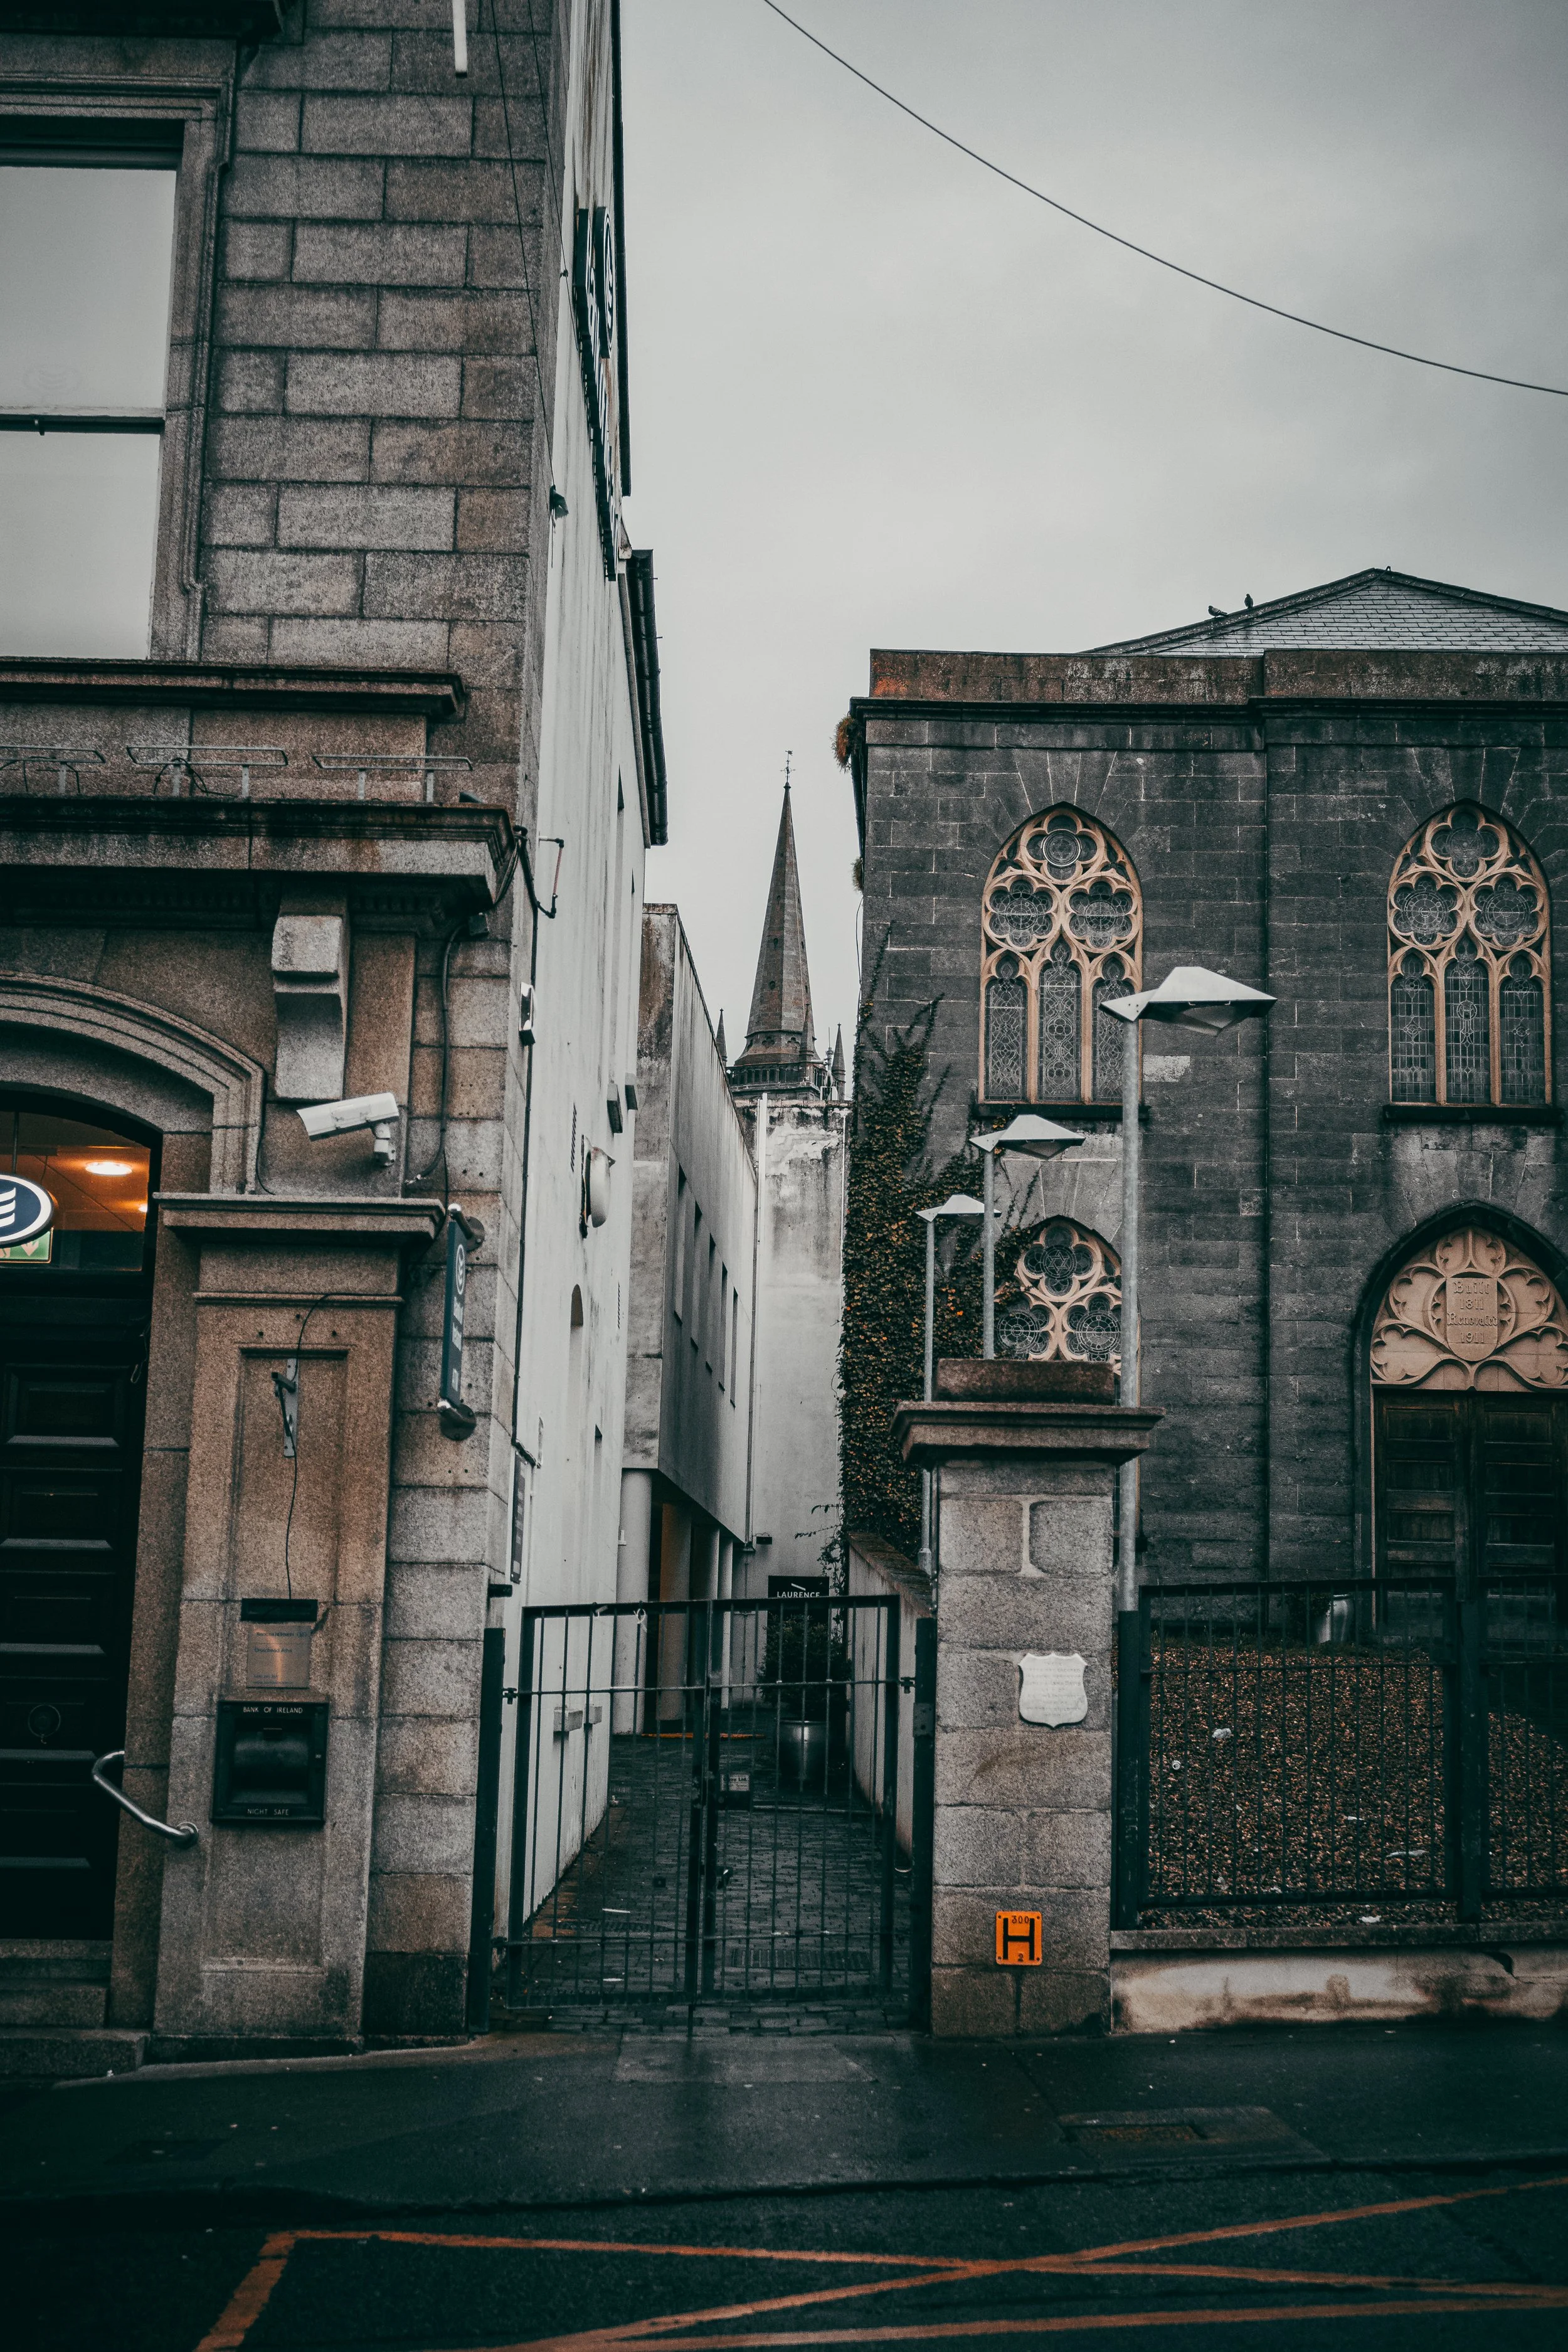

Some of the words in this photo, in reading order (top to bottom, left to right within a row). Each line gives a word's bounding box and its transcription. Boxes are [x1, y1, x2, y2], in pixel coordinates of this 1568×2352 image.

[1453, 1281, 1490, 1295] Built
[1459, 1299, 1484, 1310] 1811
[1446, 1312, 1498, 1327] Renovated
[1460, 1332, 1485, 1343] 1911
[1012, 1915, 1029, 1924] 300
[1003, 1917, 1035, 1961] H
[1018, 1952, 1024, 1963] 2
